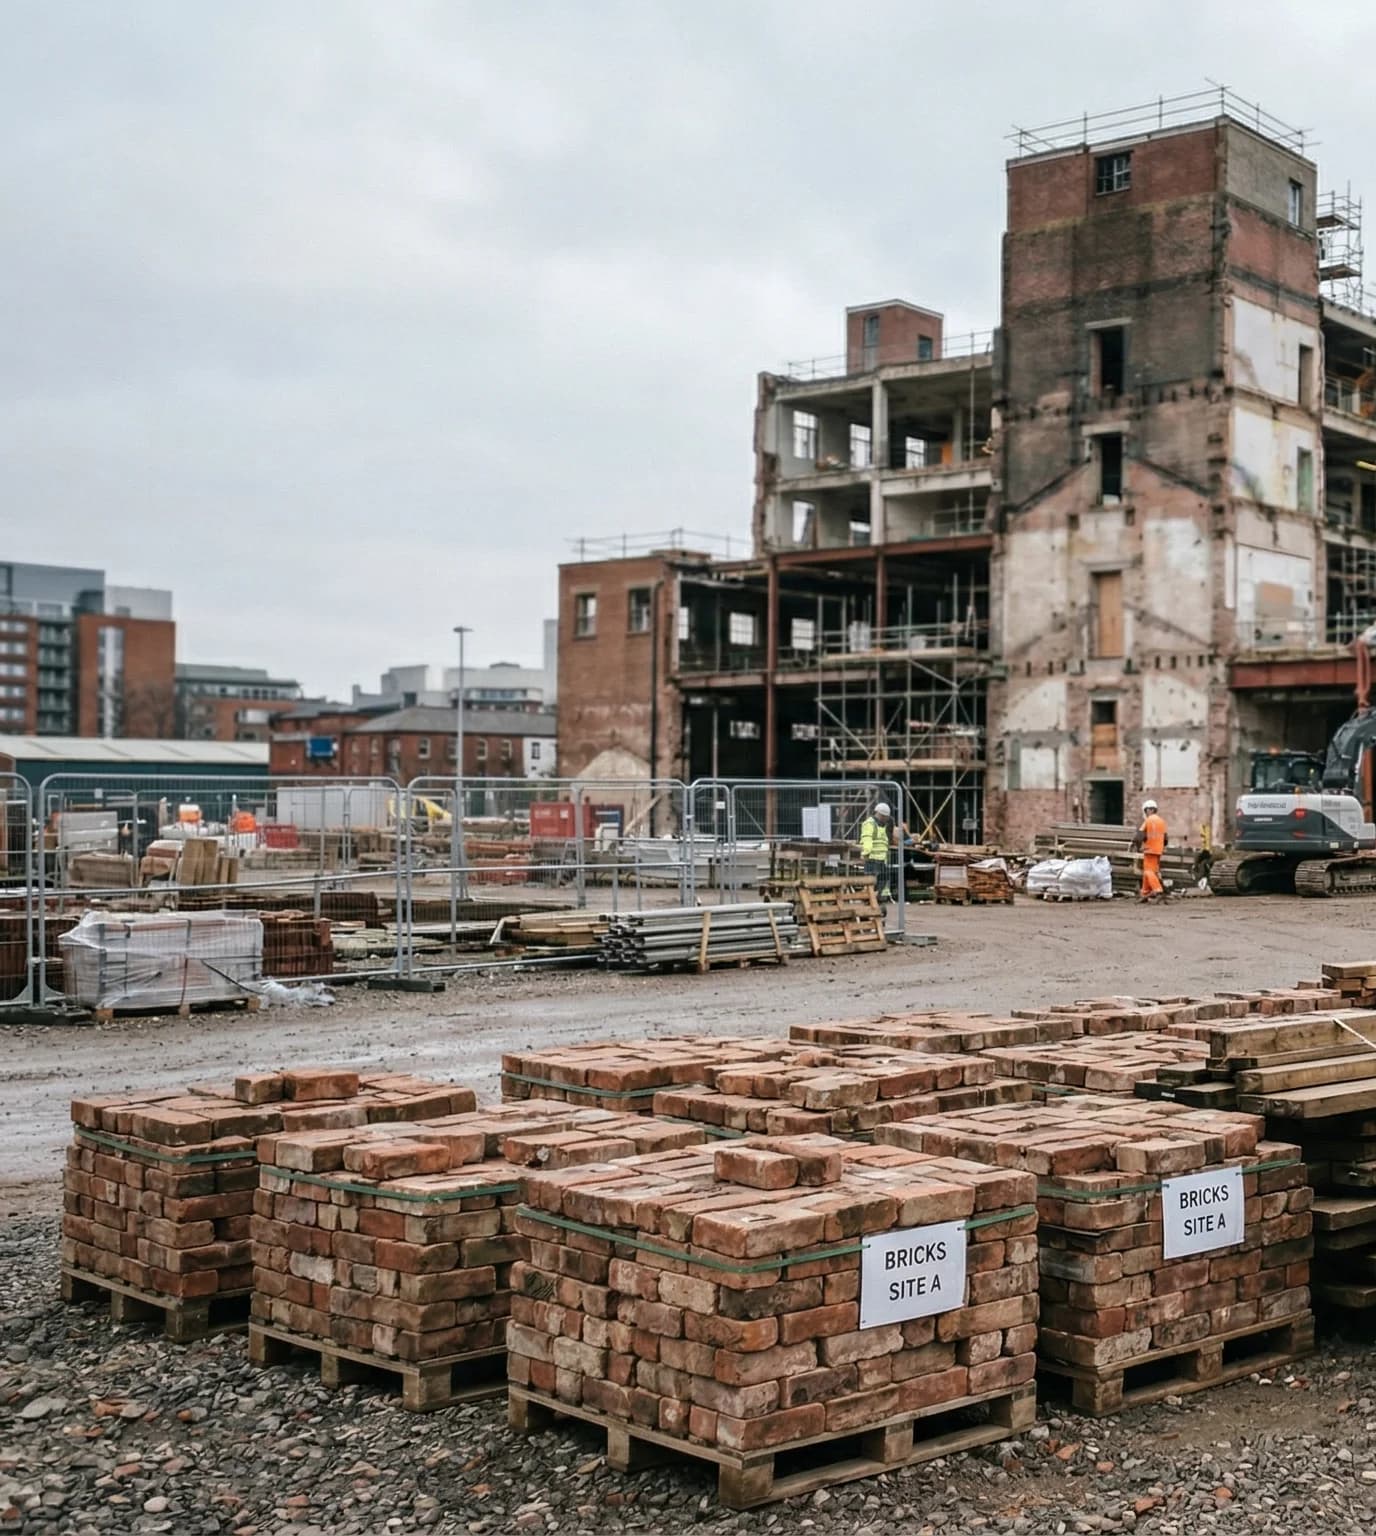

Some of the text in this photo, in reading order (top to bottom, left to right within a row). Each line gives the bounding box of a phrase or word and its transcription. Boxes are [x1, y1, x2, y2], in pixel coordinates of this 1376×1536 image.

[1179, 1184, 1229, 1210] BRICKS
[1183, 1213, 1226, 1236] SITE A
[885, 1241, 947, 1271] BRICKS
[889, 1273, 941, 1301] SITE A
